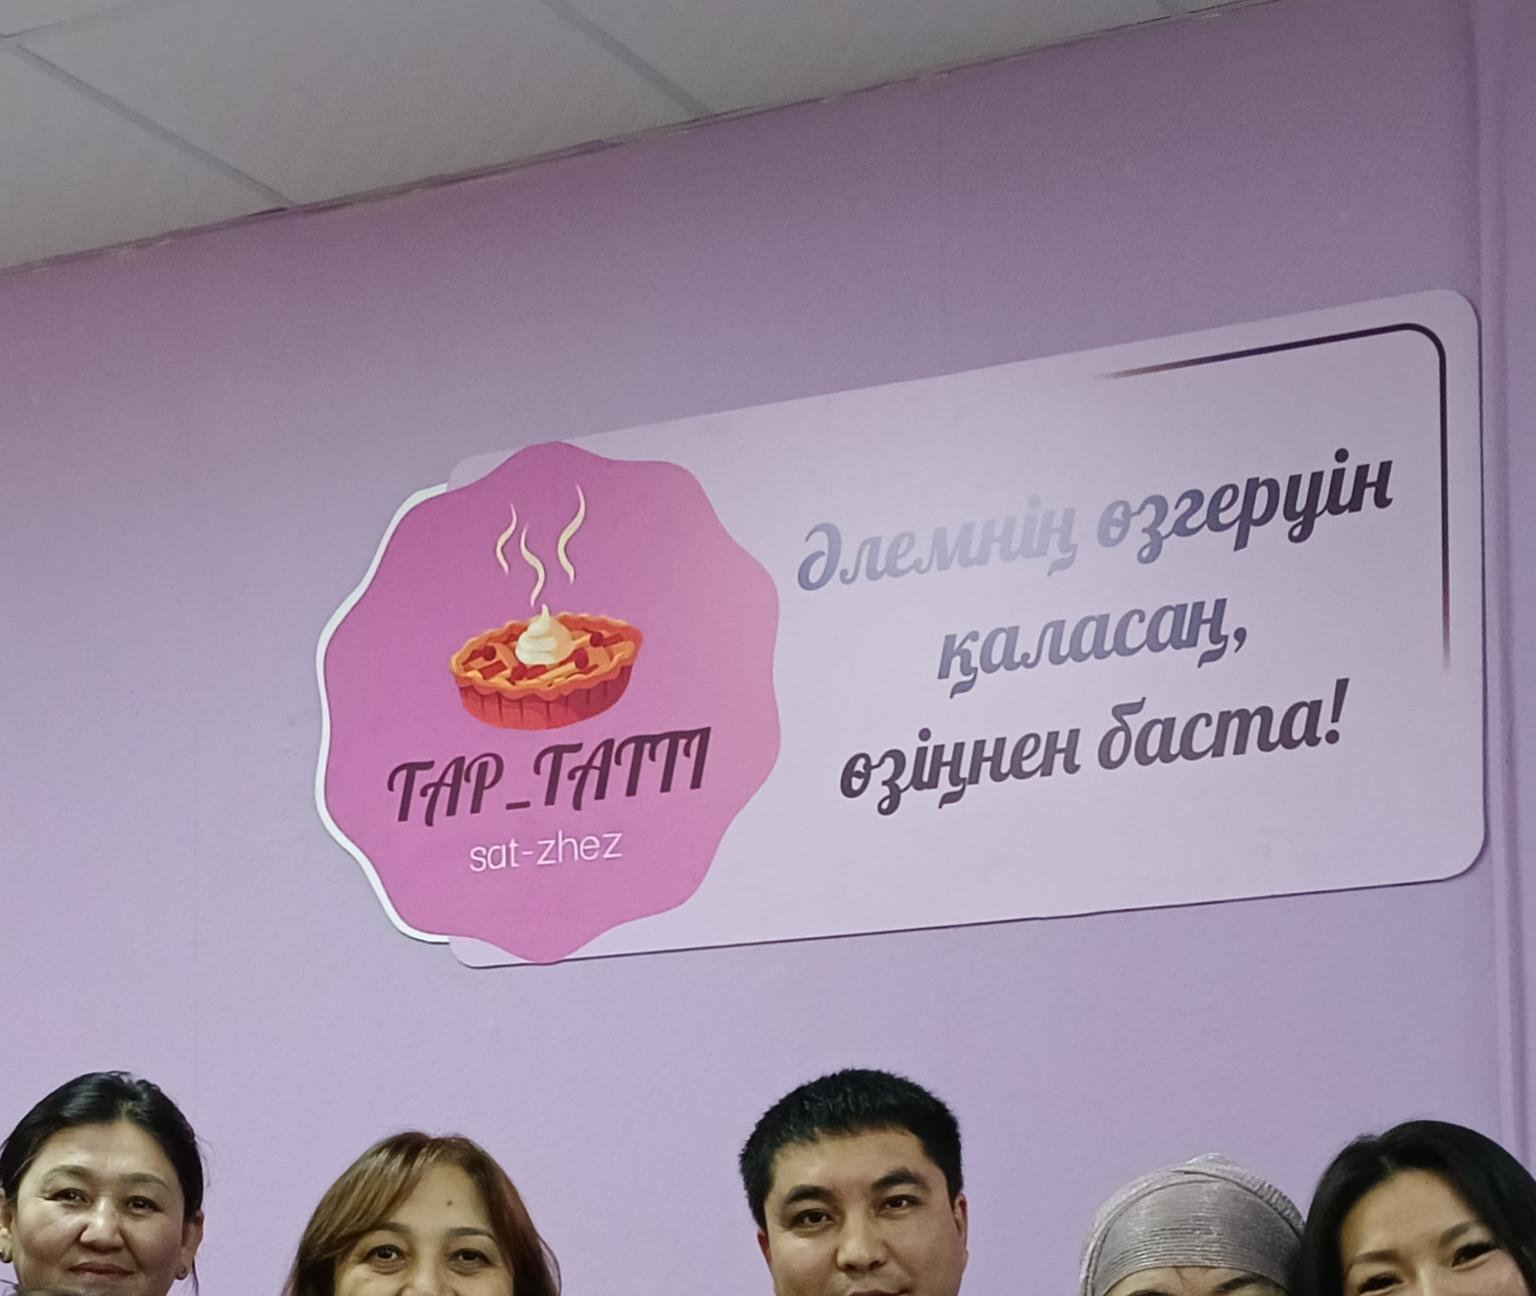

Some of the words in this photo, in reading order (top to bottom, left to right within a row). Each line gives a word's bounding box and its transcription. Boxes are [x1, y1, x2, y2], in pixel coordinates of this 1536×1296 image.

[797, 495, 1079, 592] Әлемнің
[1096, 447, 1394, 565] өзгеруін
[937, 597, 1248, 699] қаласаң,
[839, 727, 1082, 816] өзіңнен
[1097, 677, 1351, 771] баста!
[469, 829, 624, 872] sat-zhez
